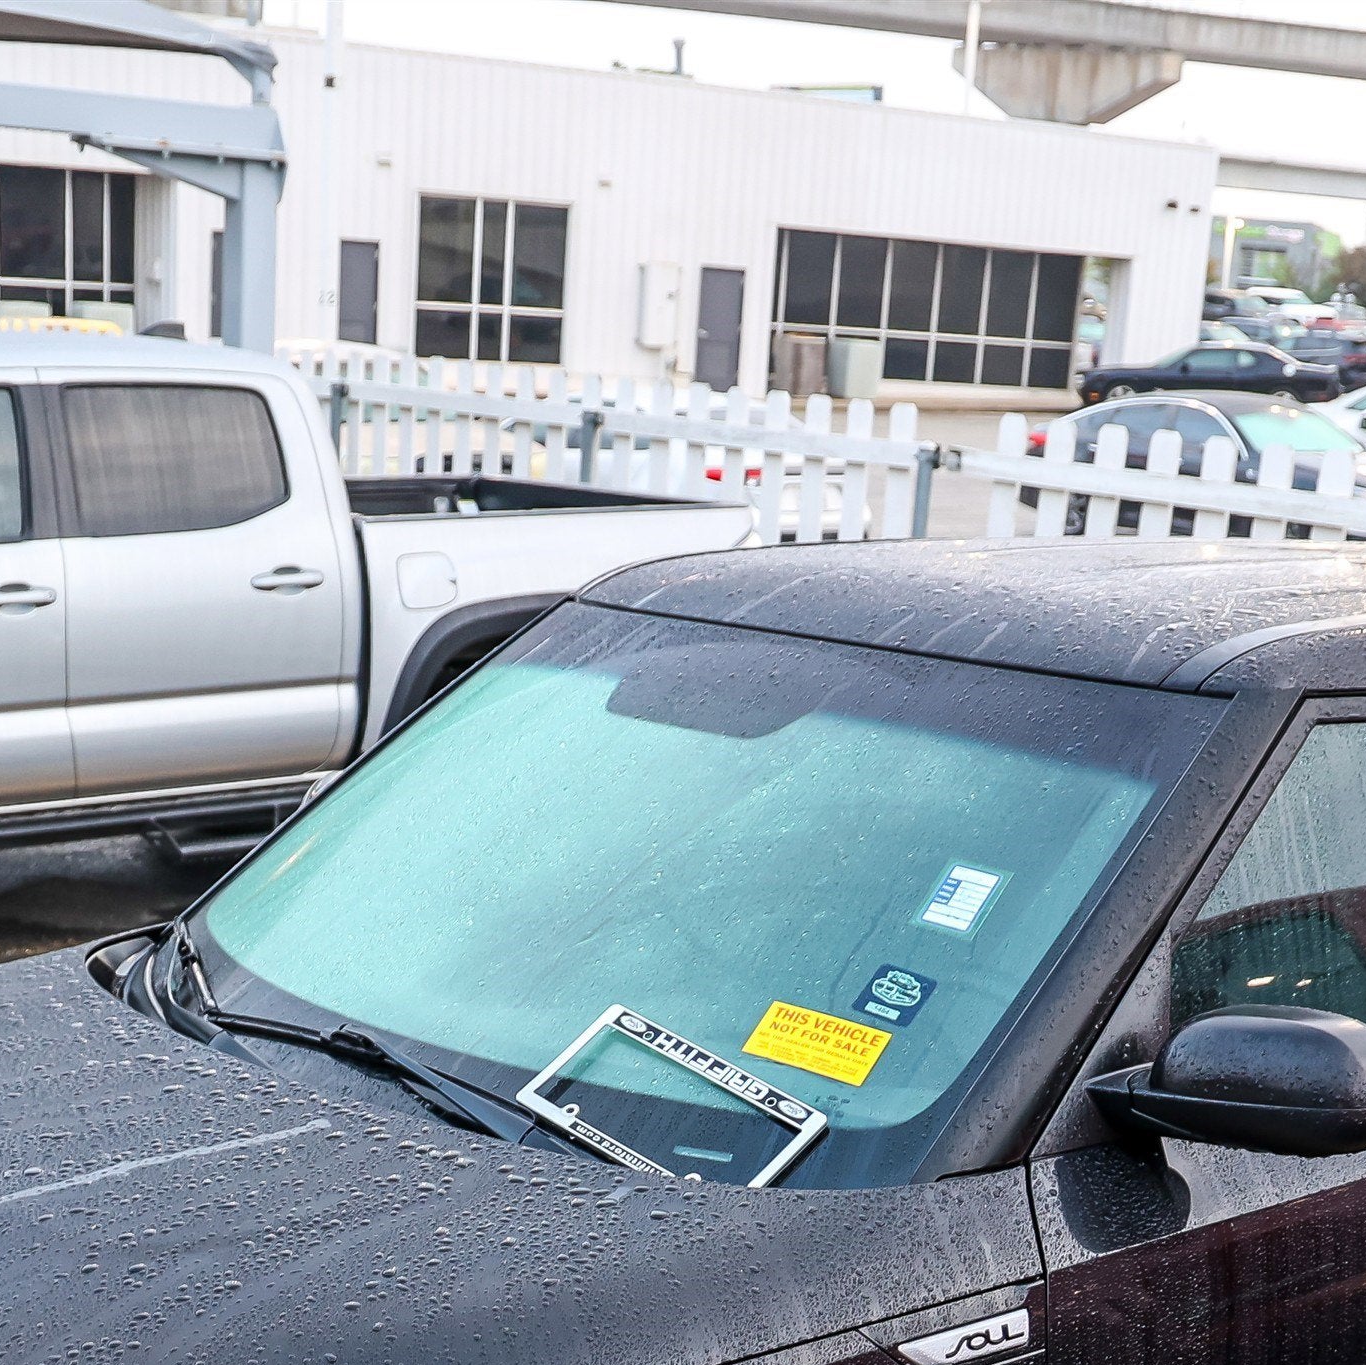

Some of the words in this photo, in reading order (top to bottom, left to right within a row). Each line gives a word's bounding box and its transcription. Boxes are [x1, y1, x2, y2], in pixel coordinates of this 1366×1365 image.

[769, 1021, 798, 1036] NOT
[800, 1030, 831, 1045] FOR
[832, 1040, 871, 1057] SALE
[775, 1007, 811, 1025] THIS
[814, 1017, 884, 1047] VEHICLE
[653, 1032, 770, 1101] GRIFFITH
[945, 1324, 1024, 1358] SOUL
